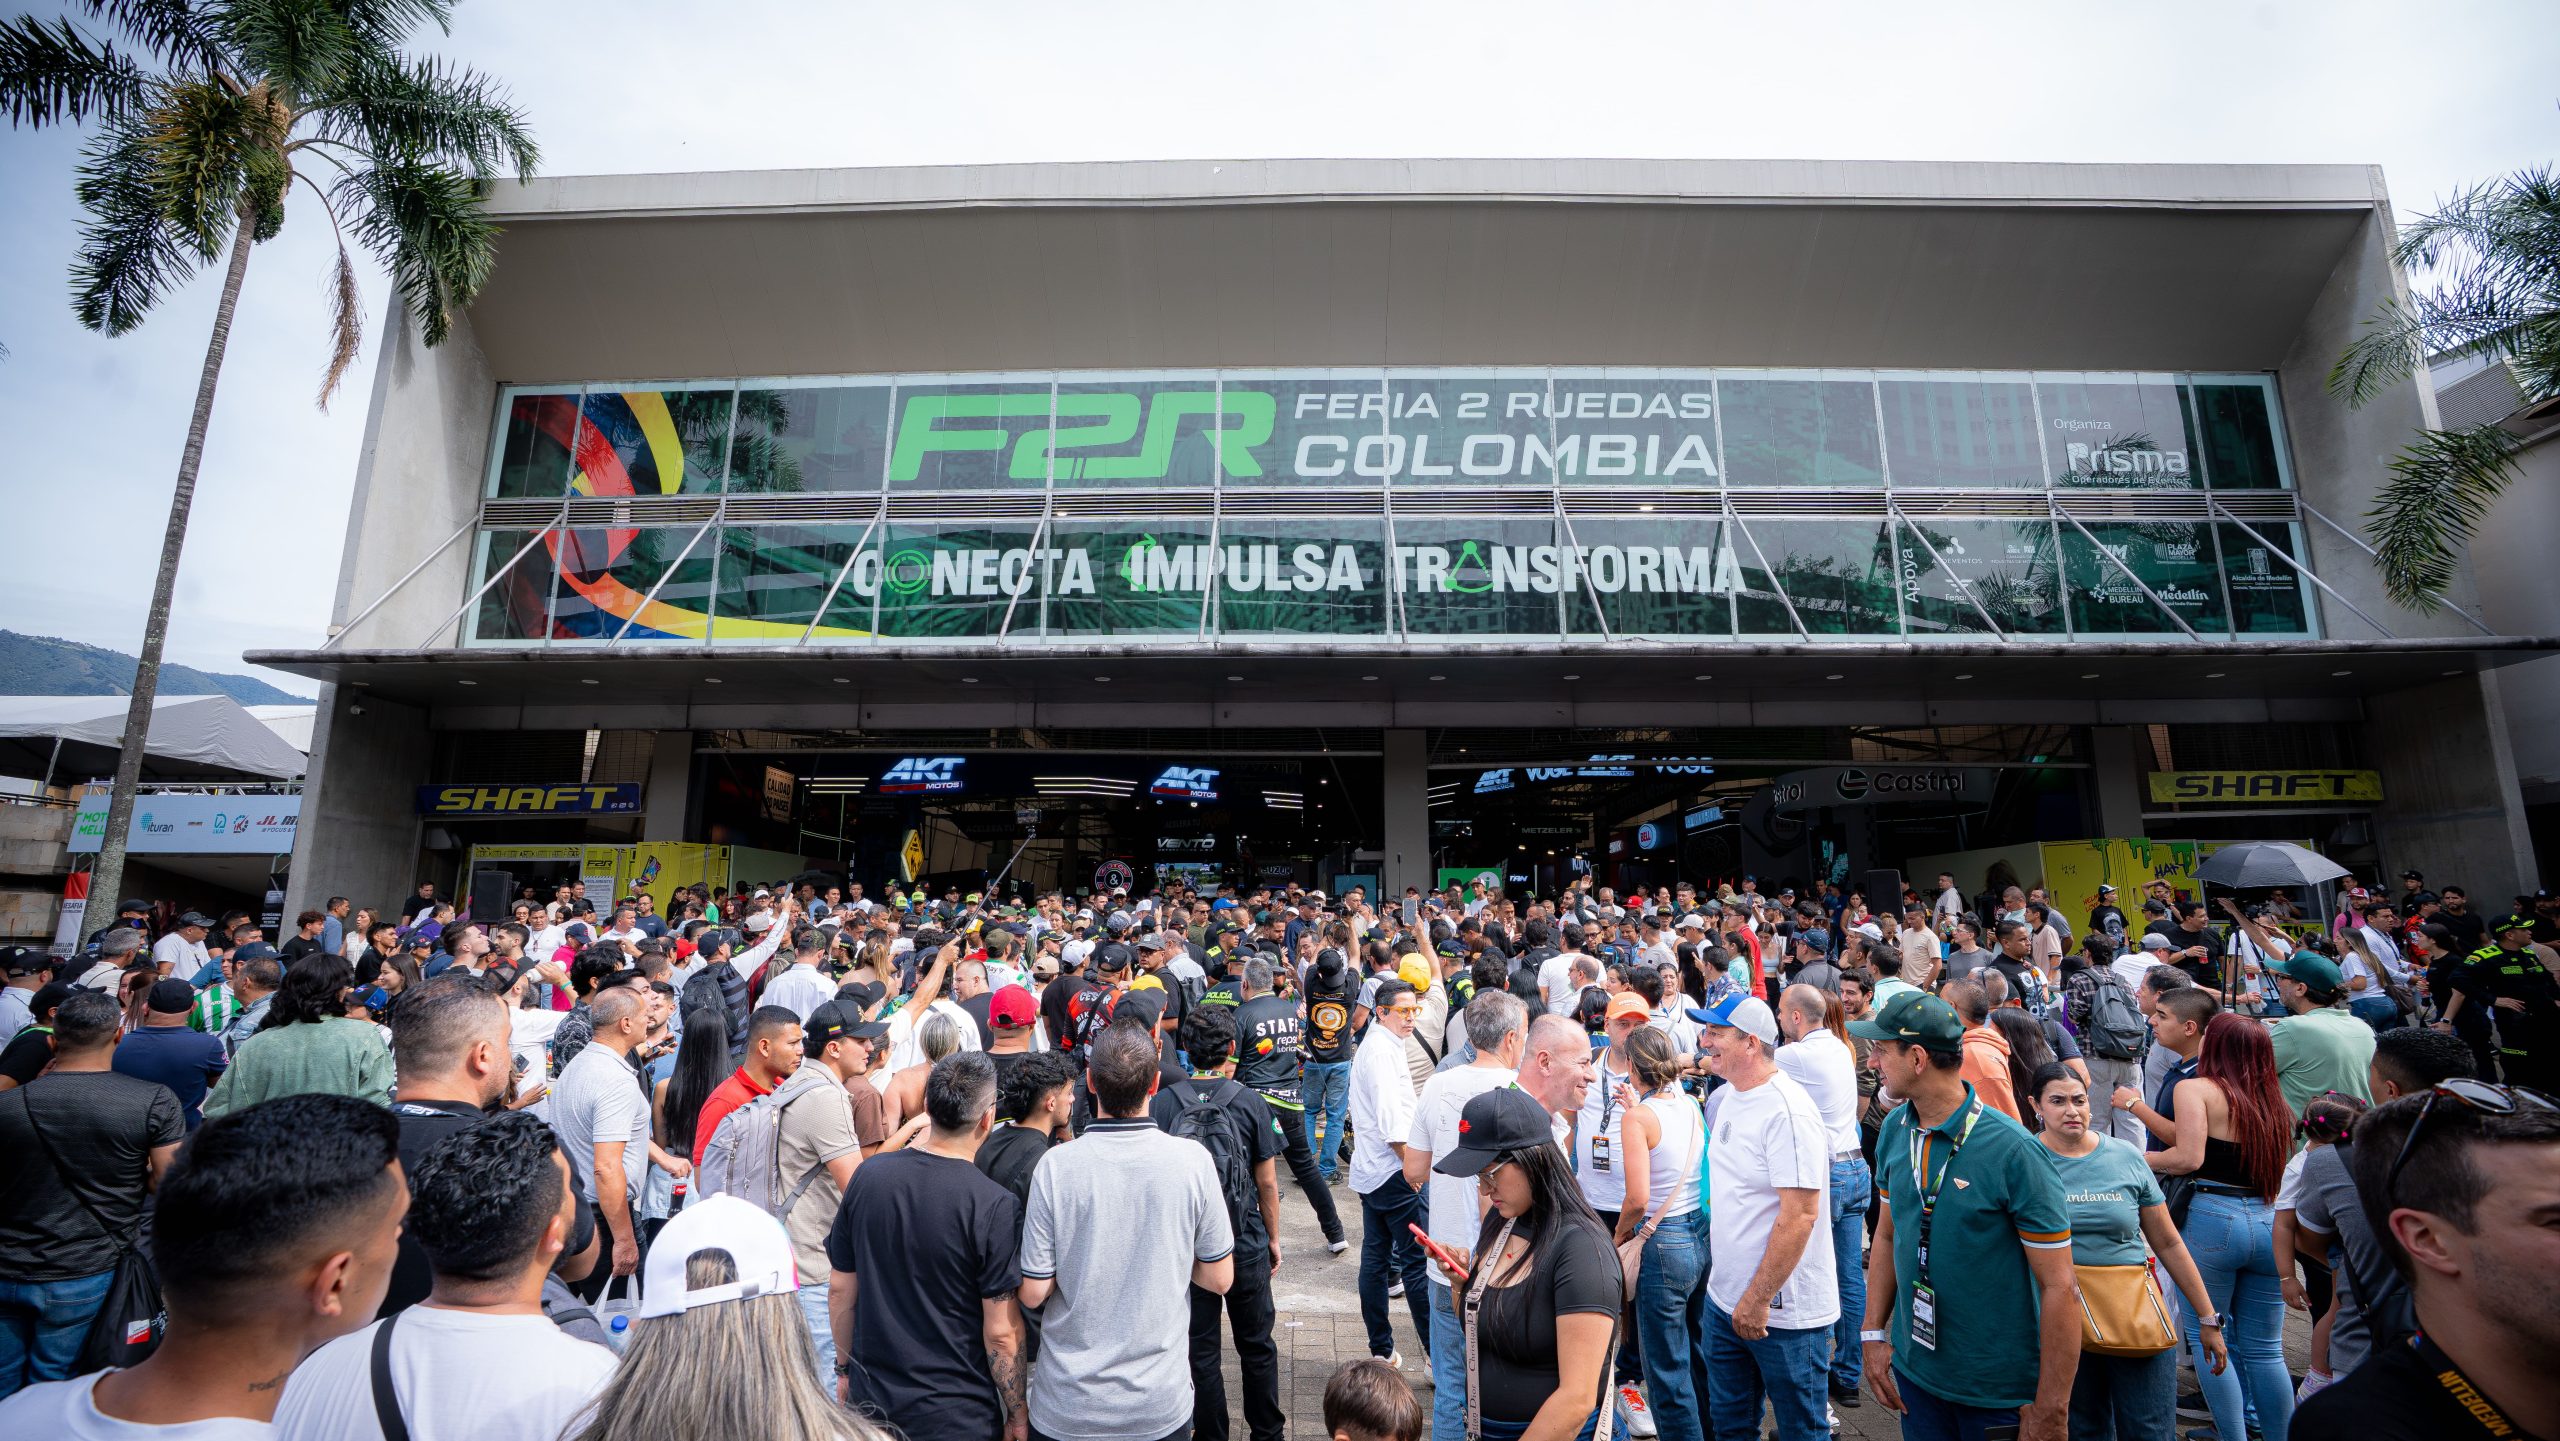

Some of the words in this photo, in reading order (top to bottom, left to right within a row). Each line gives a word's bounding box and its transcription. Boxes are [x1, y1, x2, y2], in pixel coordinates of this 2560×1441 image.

[1294, 393, 1439, 419] FERIA
[1456, 393, 1489, 418] 2
[1506, 392, 1712, 418] RUEDAS
[889, 391, 1276, 481] F2R
[2053, 418, 2112, 431] Organiza
[1294, 434, 1718, 476] COLOMBIA
[2066, 442, 2187, 473] Prisma
[852, 547, 1096, 596] CONECTA
[1128, 543, 1364, 592] IMPULSA
[1392, 543, 1747, 594] TRANSFORMA
[1902, 548, 1921, 603] Apoya
[2109, 595, 2144, 604] BUREAU
[2156, 588, 2209, 600] Medellín
[881, 757, 967, 780] AKT
[1151, 766, 1220, 789] AKT
[925, 781, 959, 790] MOTOS
[1873, 771, 1967, 793] Castrol
[2174, 774, 2357, 798] SHAFT
[436, 787, 618, 811] SHAFT
[1190, 790, 1217, 798] MOTOS
[147, 820, 174, 833] ituran
[1639, 829, 1651, 843] BELL
[1157, 838, 1216, 849] VENTO
[586, 859, 613, 867] F2R
[1206, 990, 1233, 1000] POLICÍA
[1076, 1011, 1106, 1026] BIKRS
[1468, 1324, 1476, 1372] Christian
[1469, 1384, 1478, 1410] Dior
